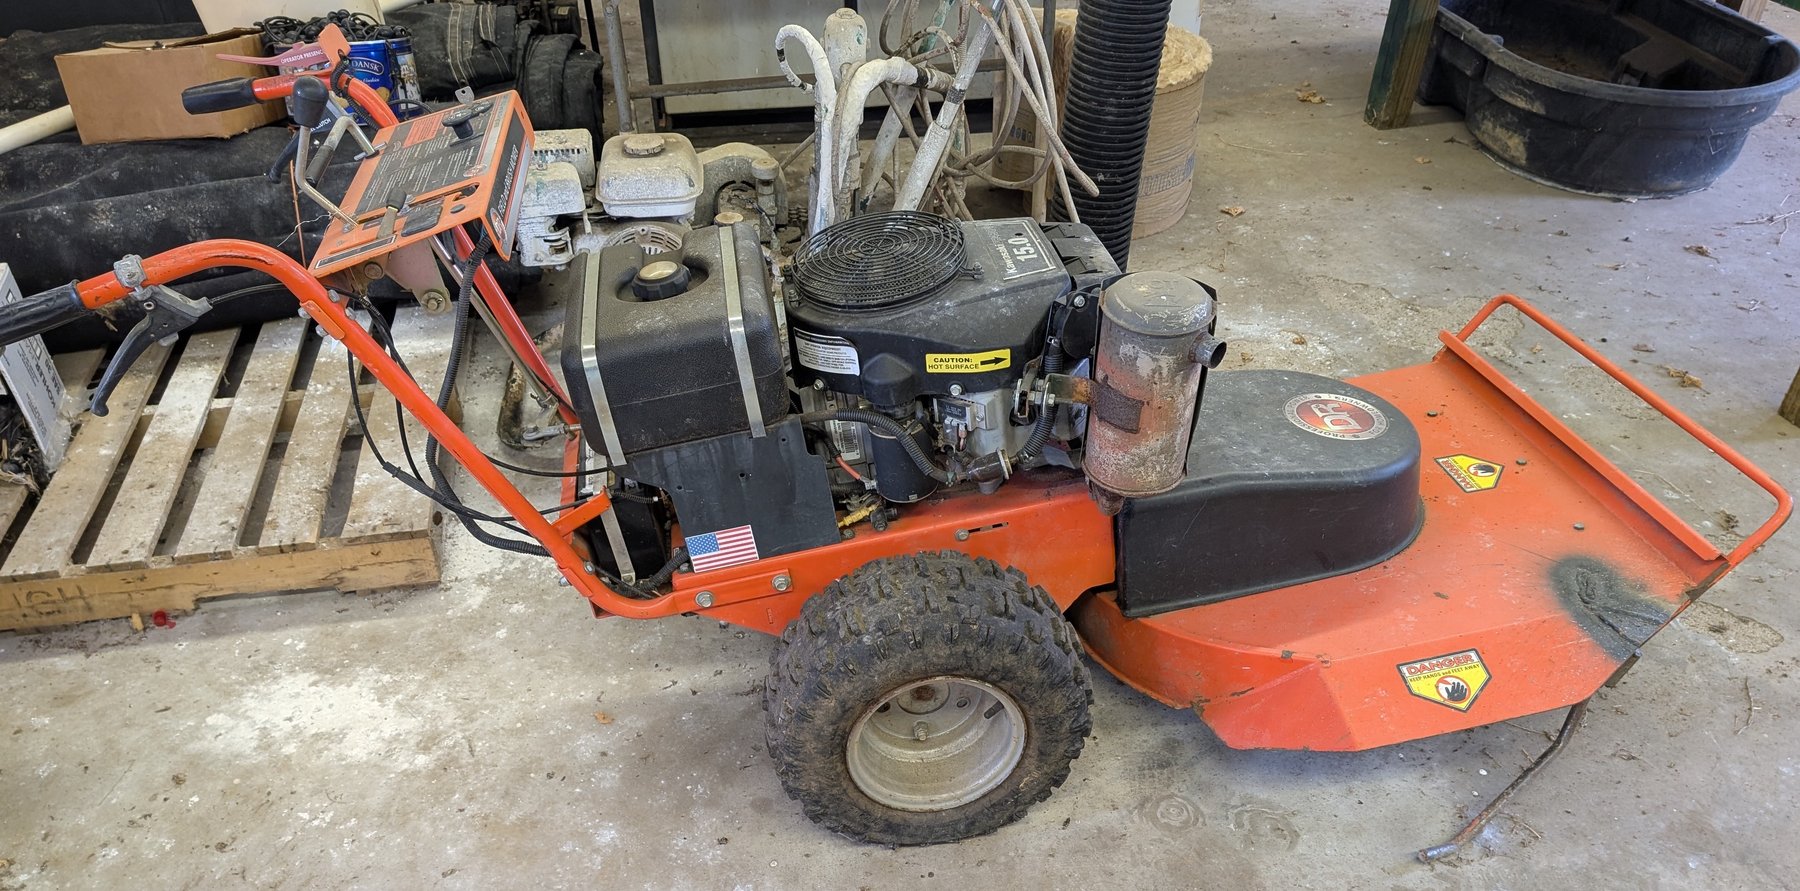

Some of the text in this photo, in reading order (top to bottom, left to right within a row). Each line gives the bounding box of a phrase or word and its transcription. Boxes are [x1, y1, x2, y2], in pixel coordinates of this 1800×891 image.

[280, 50, 324, 64] OPERATOR PRESENC
[352, 60, 380, 72] DANSK
[995, 244, 1017, 274] Kawasaki
[1008, 238, 1037, 262] 15.0
[36, 362, 56, 408] KOHLER
[1311, 402, 1362, 431] DR
[1406, 654, 1474, 676] DANGER
[1423, 671, 1441, 680] HANDS
[1452, 666, 1464, 674] FEET
